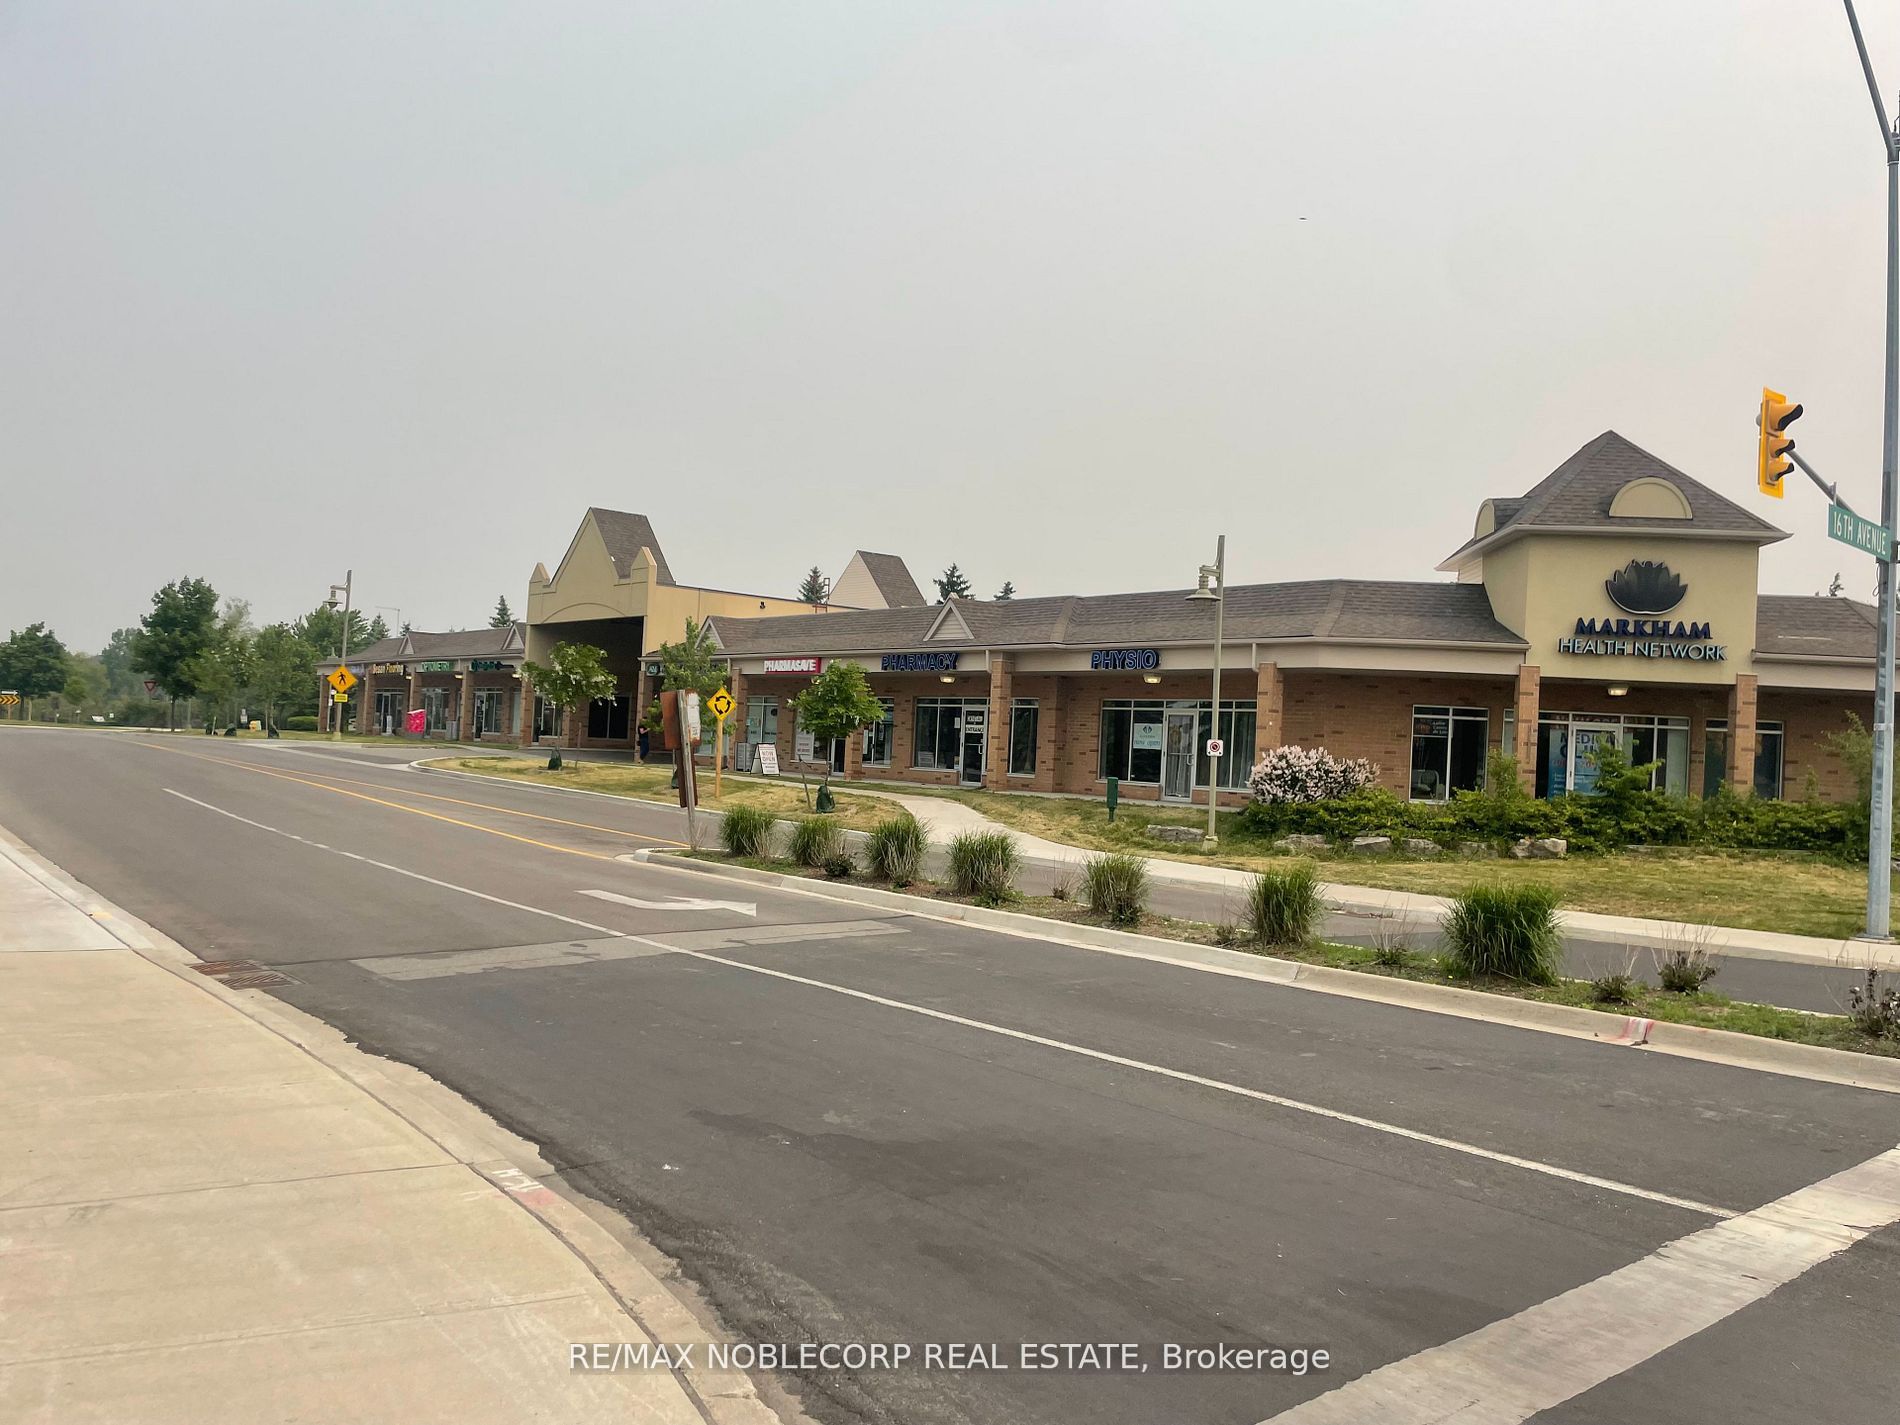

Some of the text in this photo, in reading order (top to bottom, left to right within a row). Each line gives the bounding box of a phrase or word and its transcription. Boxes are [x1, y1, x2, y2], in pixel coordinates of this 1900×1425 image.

[1833, 511, 1886, 555] 16TH AVENUE
[1574, 617, 1713, 639] MARKHAM
[1091, 648, 1160, 670] PHYSIO
[1558, 637, 1728, 661] HEALTH NETWORK
[764, 658, 817, 672] PHARMASAVE
[881, 653, 959, 672] PHARMACY
